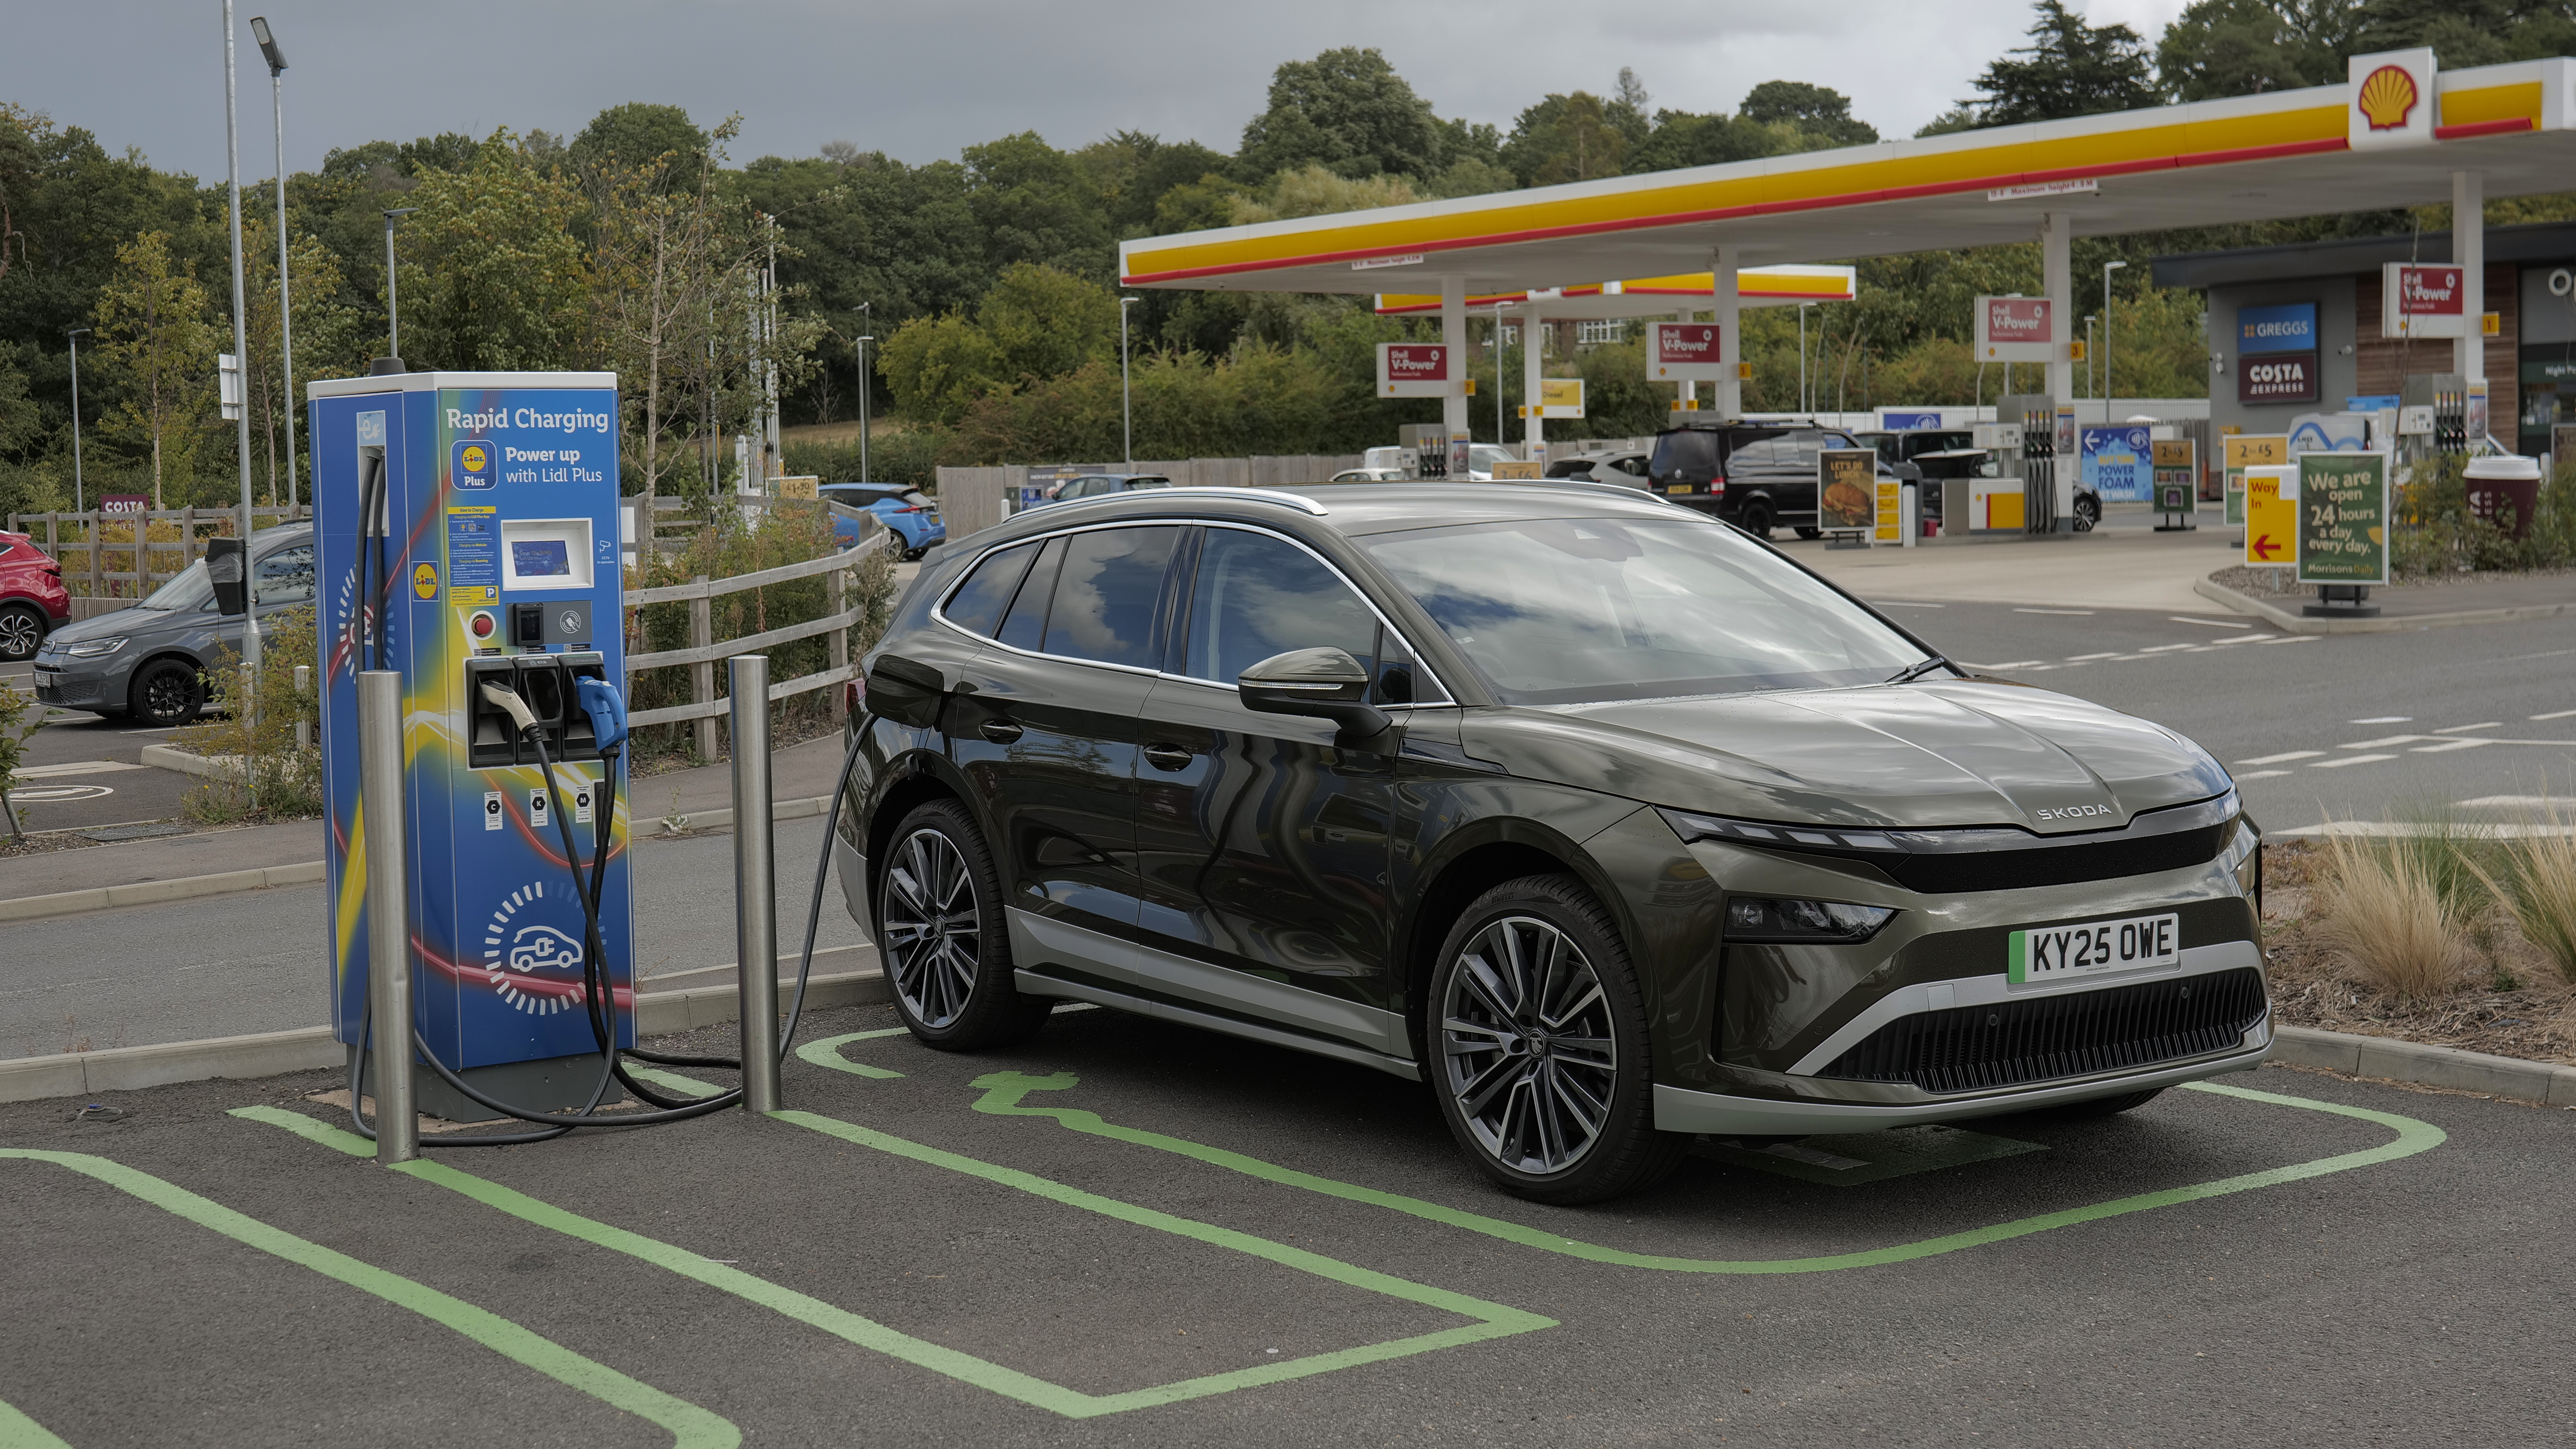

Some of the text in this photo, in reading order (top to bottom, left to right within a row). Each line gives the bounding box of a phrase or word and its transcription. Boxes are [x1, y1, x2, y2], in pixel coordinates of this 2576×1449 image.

[2011, 185, 2045, 196] Maximum
[2048, 182, 2069, 192] height
[2404, 273, 2422, 286] Shell
[2404, 286, 2451, 301] V-Power
[1992, 305, 2010, 316] Shell
[1992, 316, 2039, 330] V-Power
[2257, 320, 2308, 337] GREGGS
[1662, 329, 1680, 339] Shell
[1662, 339, 1709, 352] V-Power
[1391, 350, 1409, 359] Shell
[1391, 359, 1436, 370] V-Power
[2250, 363, 2304, 383] COSTA
[2545, 365, 2566, 377] Night
[2257, 382, 2304, 394] EXPRESS
[446, 408, 608, 433] Rapid Charging
[505, 447, 580, 465] Power up
[2240, 445, 2248, 458] 2
[2259, 444, 2272, 457] £5
[2099, 454, 2135, 465] BUY TIME
[1830, 461, 1863, 471] LET'S DO
[2098, 465, 2135, 476] POWER
[464, 476, 485, 486] Plus
[506, 468, 602, 483] with Lidl Plus
[1835, 471, 1859, 479] LUNCH
[2099, 477, 2135, 489] FOAM
[2308, 471, 2371, 492] We are
[2111, 490, 2135, 499] WASH
[2251, 481, 2278, 496] Way
[2329, 489, 2362, 505] open
[105, 501, 144, 513] COSTA
[2251, 498, 2262, 509] In
[2310, 504, 2376, 526] 24 hours
[2319, 524, 2352, 542] a day
[2309, 538, 2371, 557] every day.
[2308, 563, 2374, 574] Morrisons Daily
[487, 588, 495, 597] P
[1492, 892, 1515, 904] PIRELLI
[2033, 919, 2172, 972] KY25 OWE
